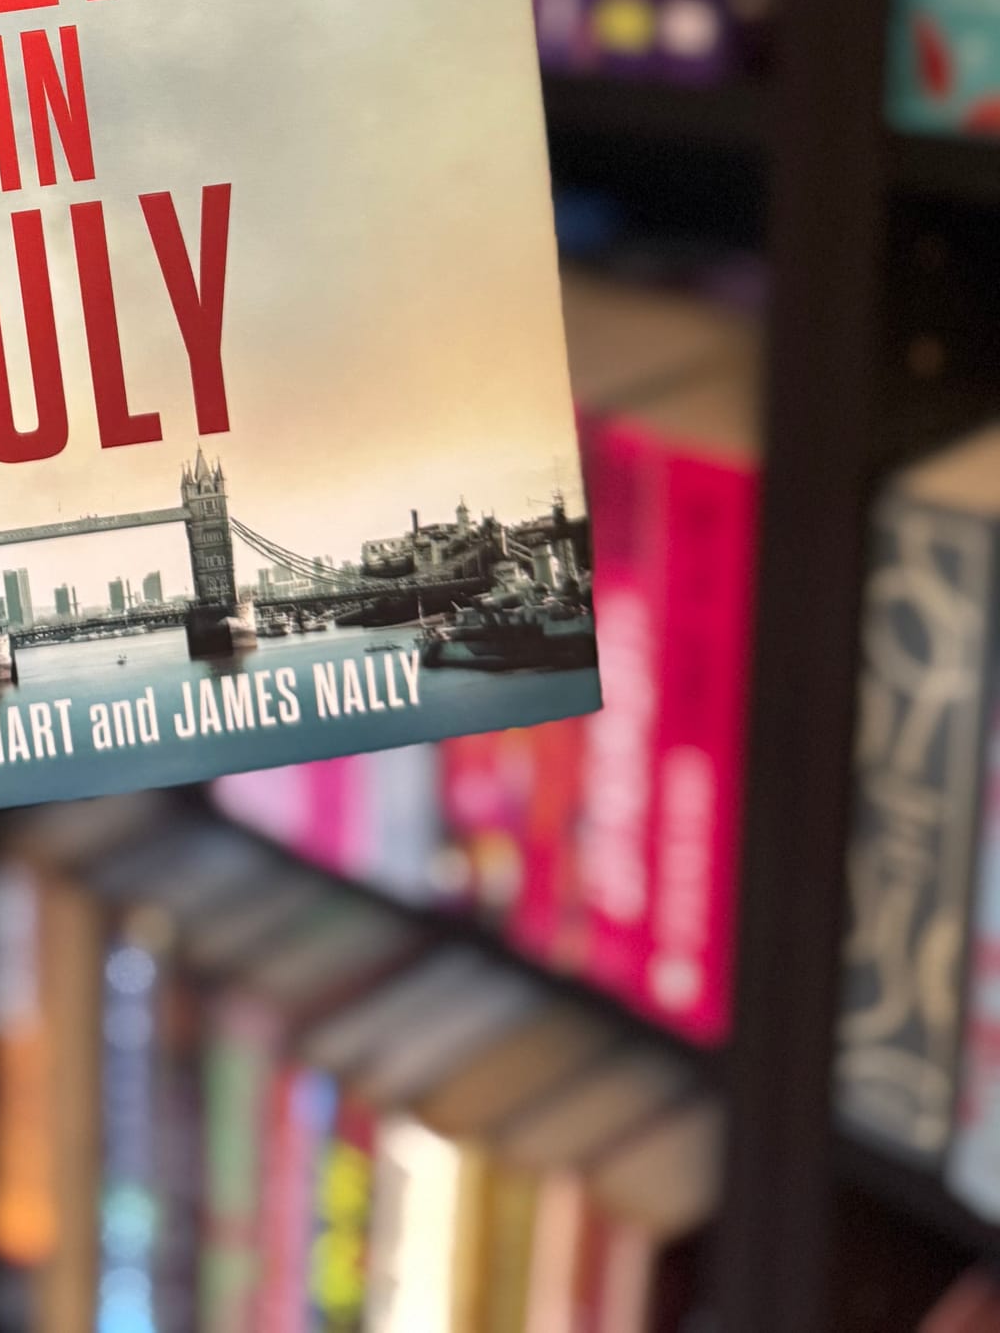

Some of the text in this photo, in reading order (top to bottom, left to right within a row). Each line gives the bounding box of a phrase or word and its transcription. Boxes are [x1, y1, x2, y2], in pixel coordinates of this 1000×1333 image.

[87, 685, 161, 752] and
[172, 665, 302, 740] JAMES
[311, 648, 422, 719] NALLY
